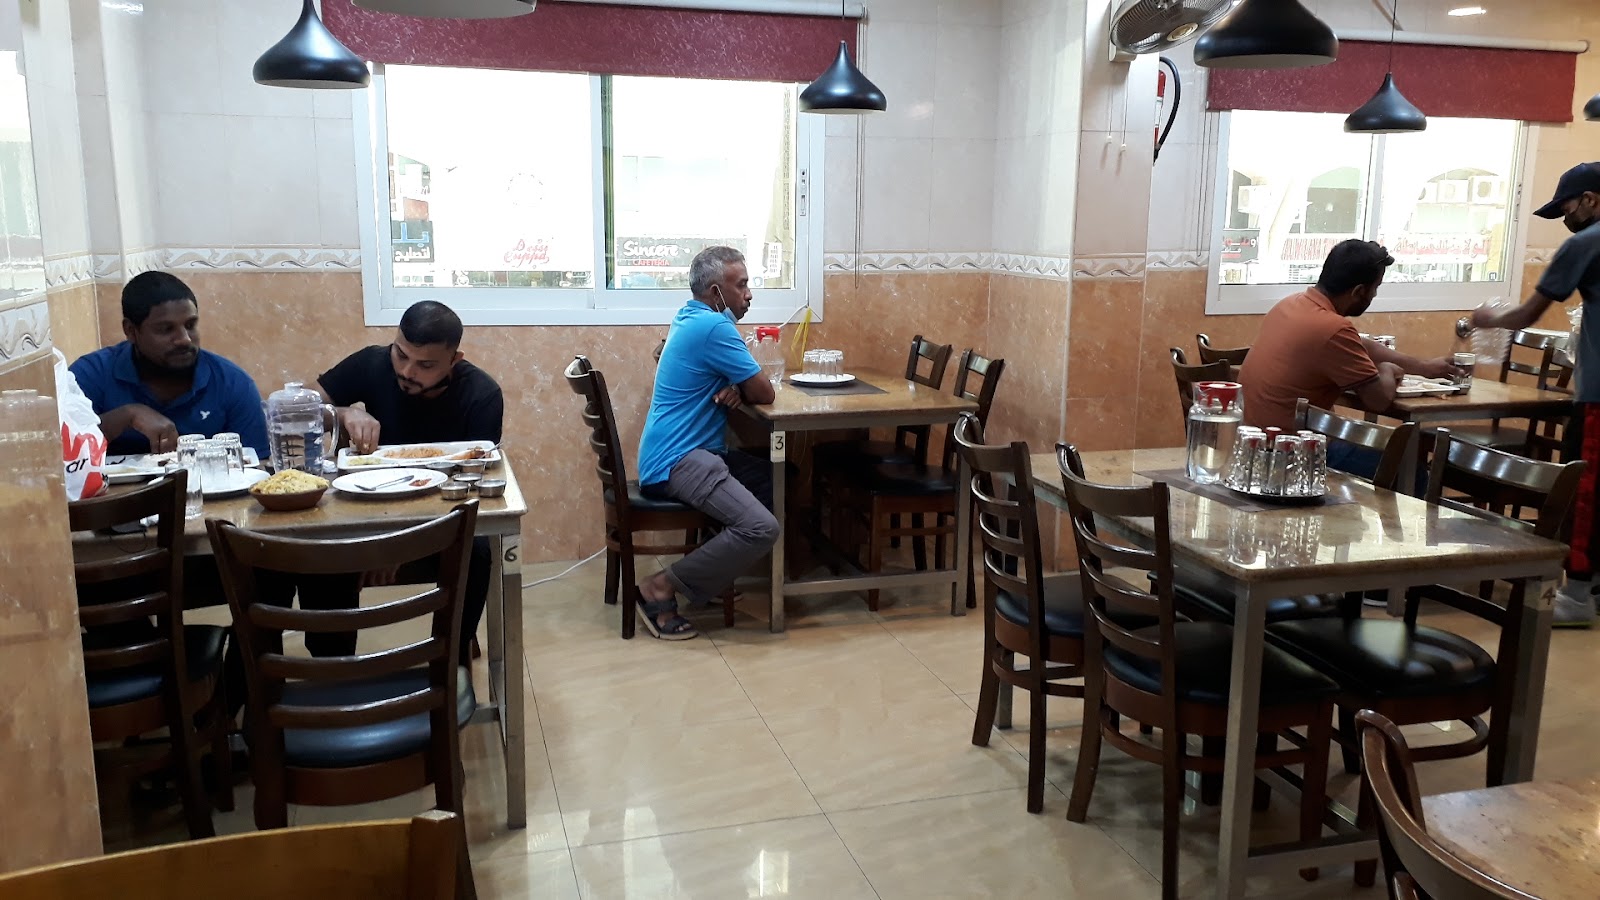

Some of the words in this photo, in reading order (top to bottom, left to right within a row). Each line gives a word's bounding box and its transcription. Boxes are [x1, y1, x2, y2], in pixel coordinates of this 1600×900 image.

[623, 240, 679, 257] Sincere
[632, 258, 670, 266] CAFETERIA
[775, 435, 784, 451] 3
[504, 545, 518, 562] 6
[1541, 586, 1556, 606] 4
